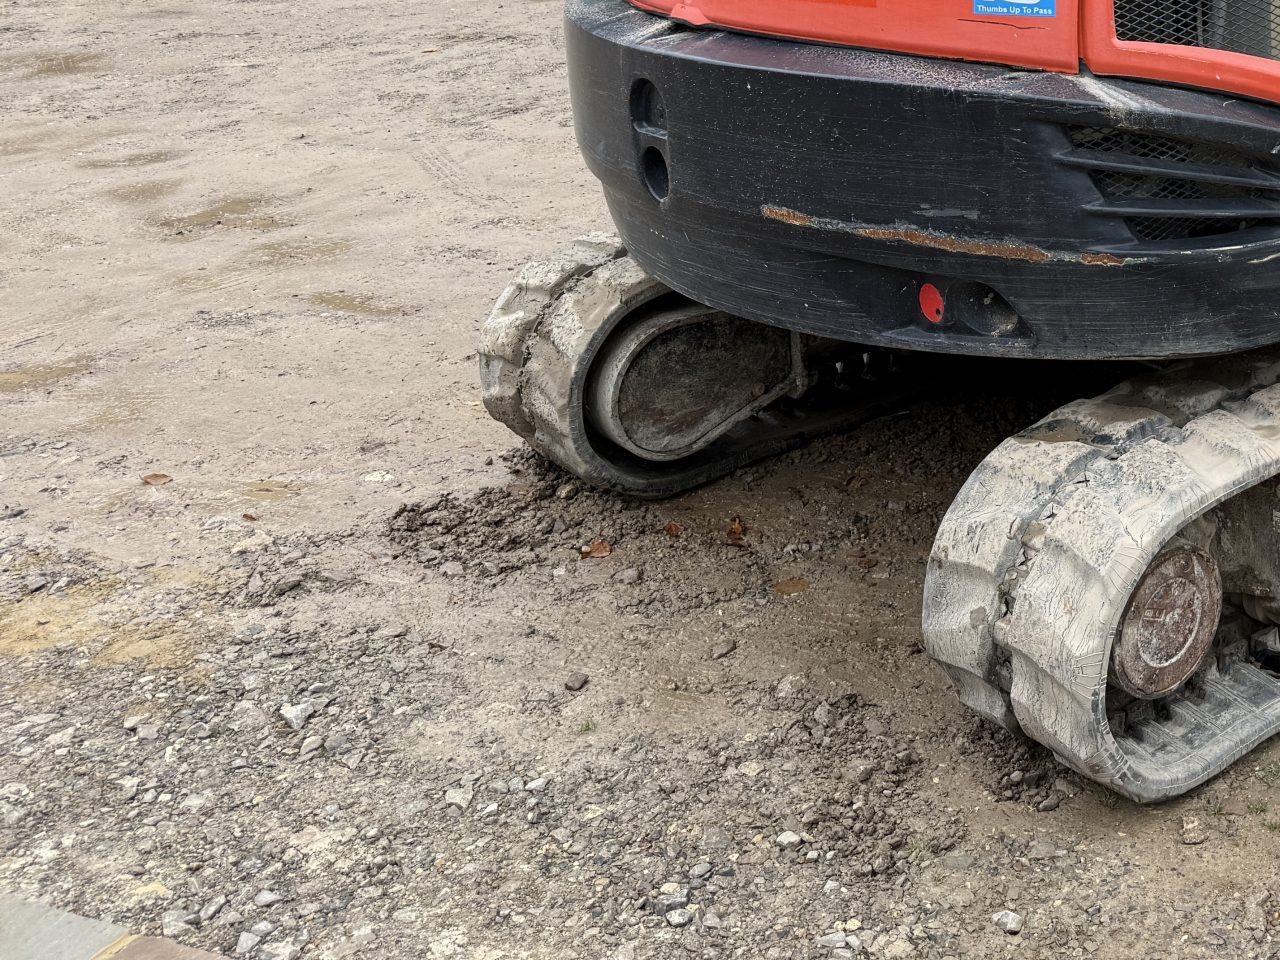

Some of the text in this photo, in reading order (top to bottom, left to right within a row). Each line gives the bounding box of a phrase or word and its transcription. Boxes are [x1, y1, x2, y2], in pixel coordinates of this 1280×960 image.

[977, 4, 1008, 13] Thumbs
[1009, 6, 1021, 14] Up
[1033, 7, 1053, 15] Pass
